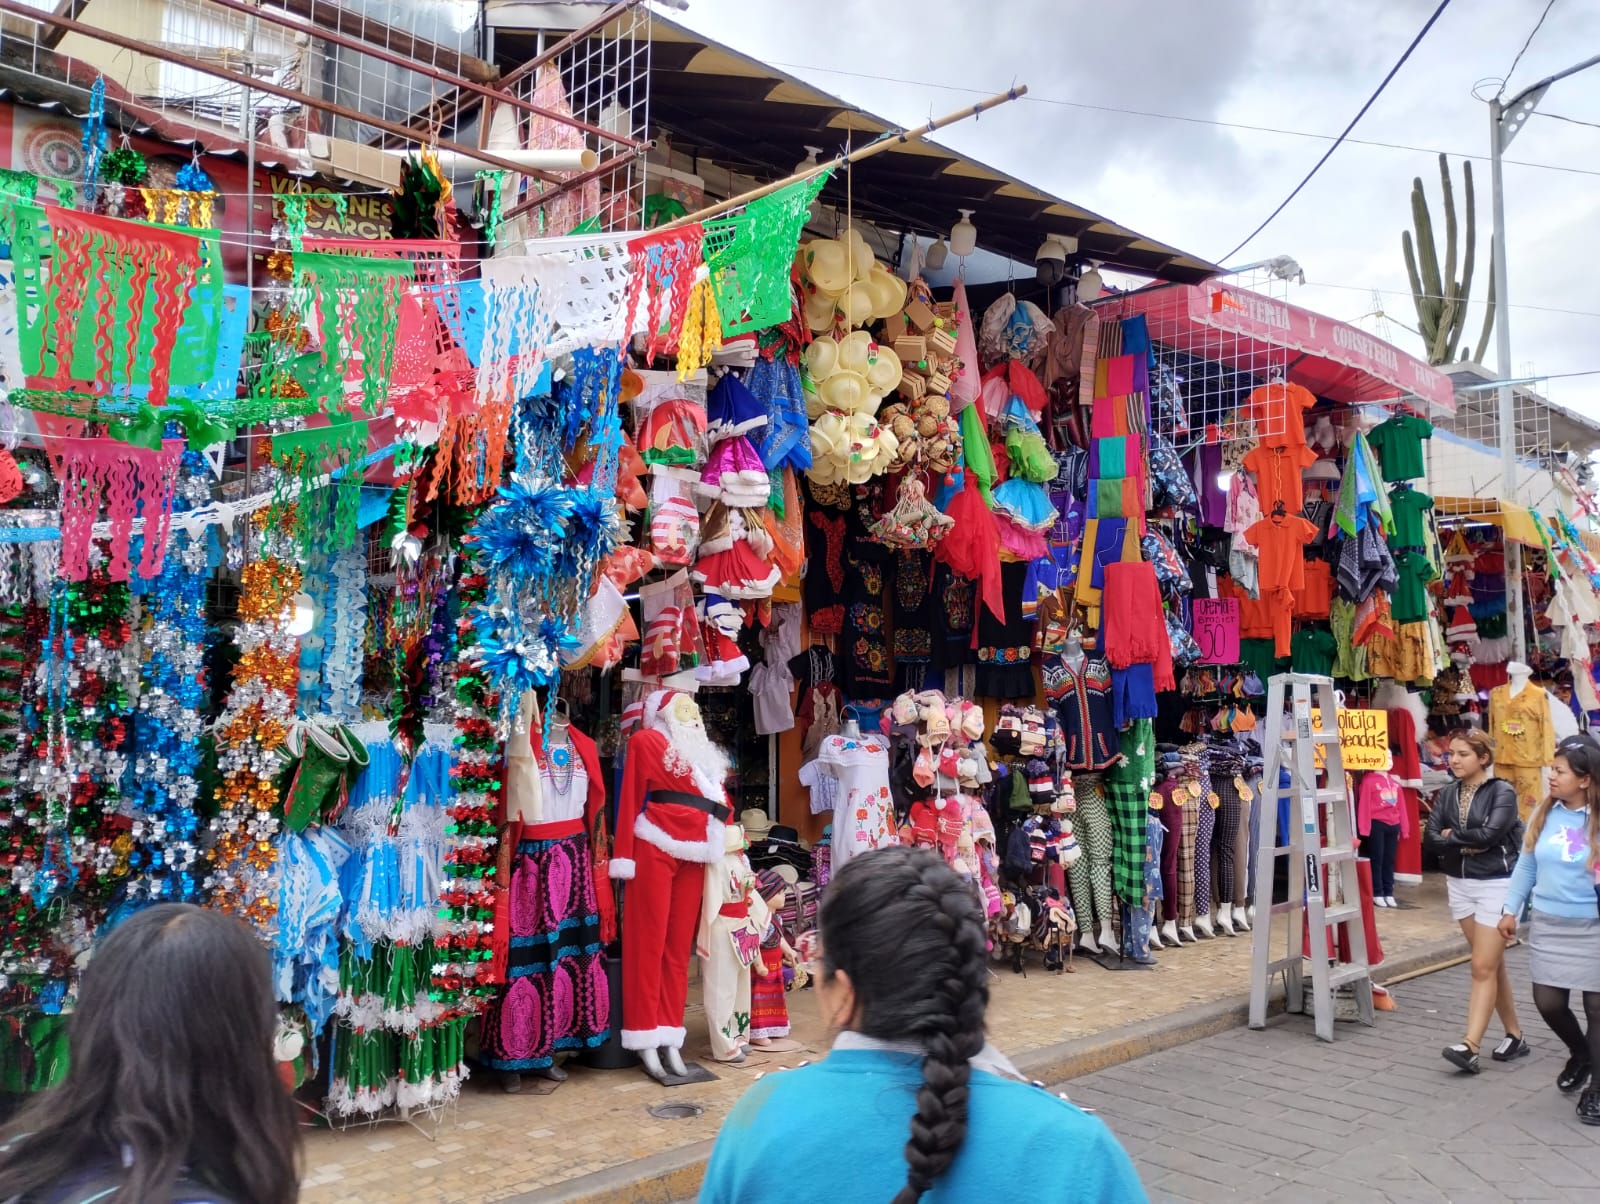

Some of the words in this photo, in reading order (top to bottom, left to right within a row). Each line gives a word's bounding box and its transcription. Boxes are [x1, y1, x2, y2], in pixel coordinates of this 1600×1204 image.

[1307, 315, 1318, 340] Y
[1332, 325, 1399, 372] CORSETERIA
[1200, 623, 1226, 660] 50
[1337, 709, 1377, 730] olicita
